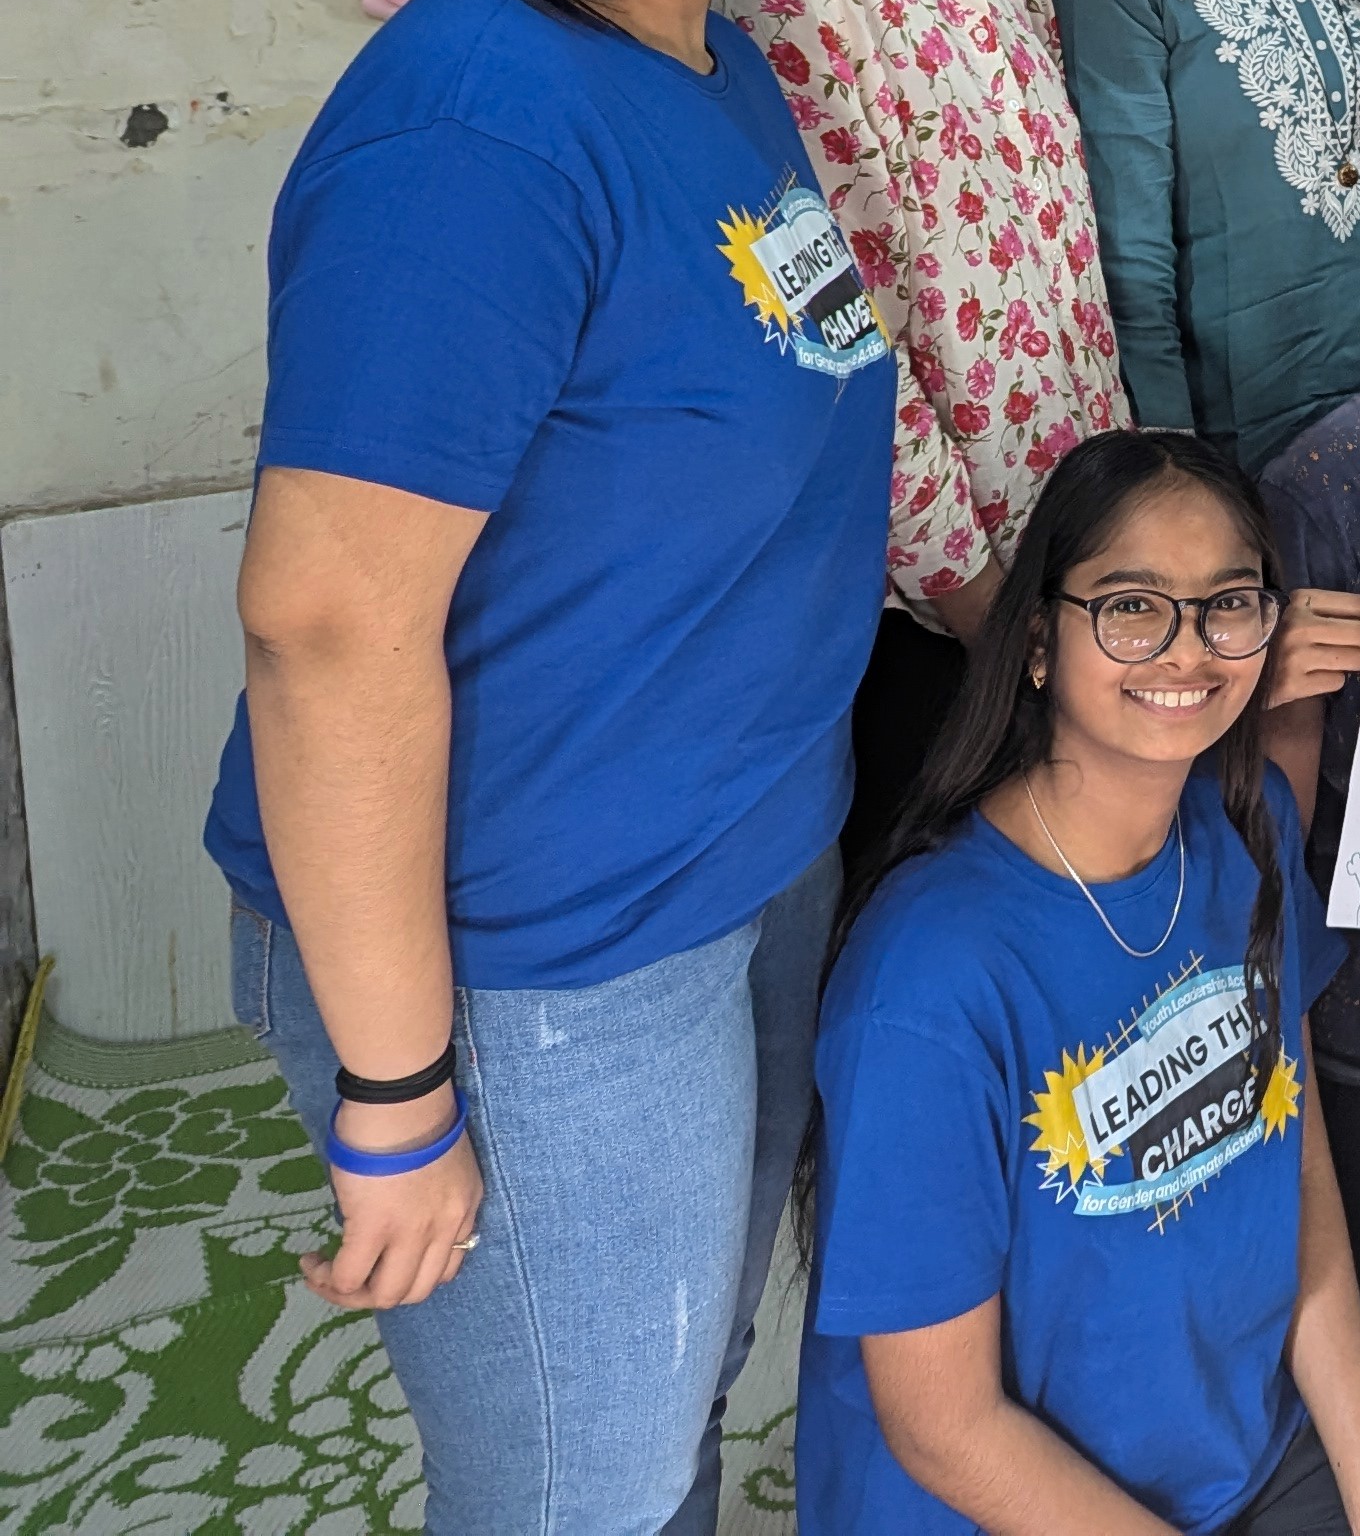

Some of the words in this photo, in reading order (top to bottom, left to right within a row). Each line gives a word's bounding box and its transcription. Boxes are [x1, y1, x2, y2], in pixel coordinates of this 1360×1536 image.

[772, 238, 834, 302] LEADING
[1141, 1007, 1172, 1035] Youth
[1170, 977, 1228, 1015] Leadership
[1088, 1032, 1210, 1146] LEADING
[1141, 1075, 1257, 1182] CHARGE
[1082, 1194, 1107, 1212] for
[1107, 1182, 1154, 1212] Gender
[1154, 1178, 1181, 1201] and
[1180, 1154, 1227, 1188] Climate
[1224, 1122, 1264, 1163] Action
